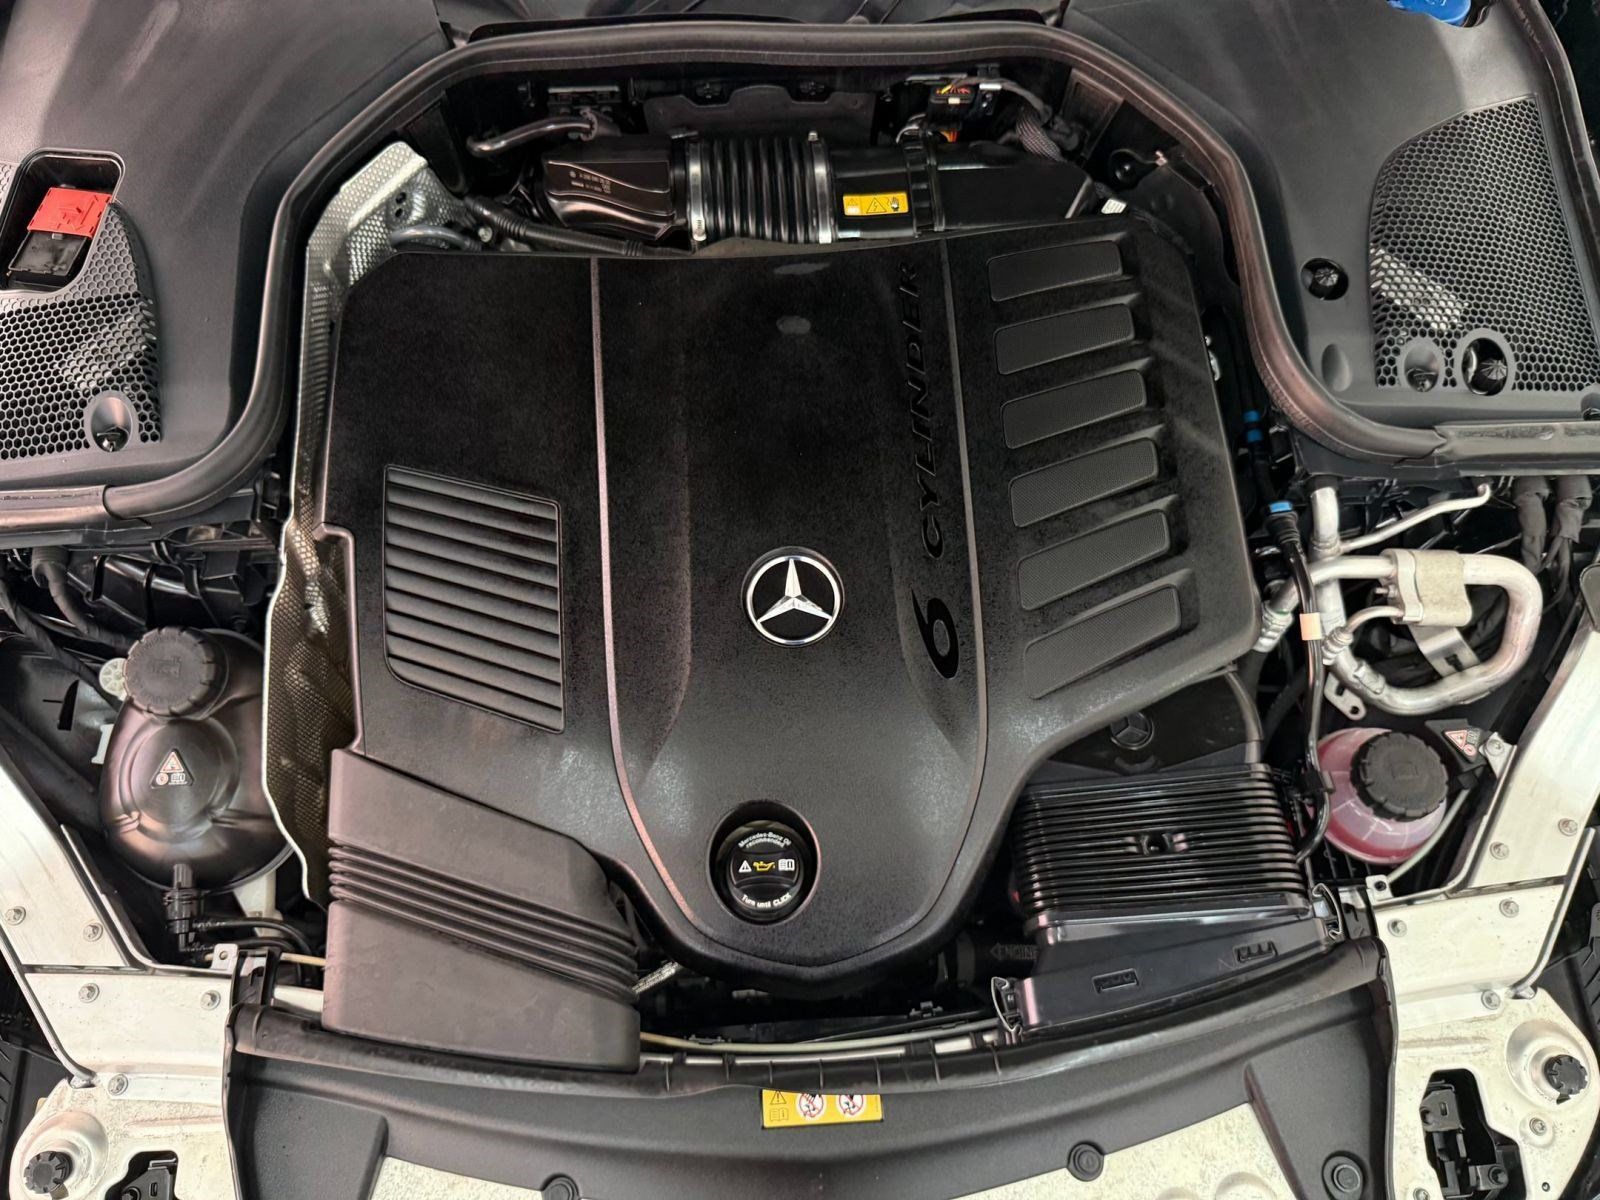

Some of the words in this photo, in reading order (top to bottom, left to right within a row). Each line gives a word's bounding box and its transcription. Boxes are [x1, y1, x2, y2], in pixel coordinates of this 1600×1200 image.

[900, 262, 944, 560] CYLINDER
[911, 587, 959, 679] 6
[742, 894, 755, 907] Turn
[773, 892, 792, 907] CLICK
